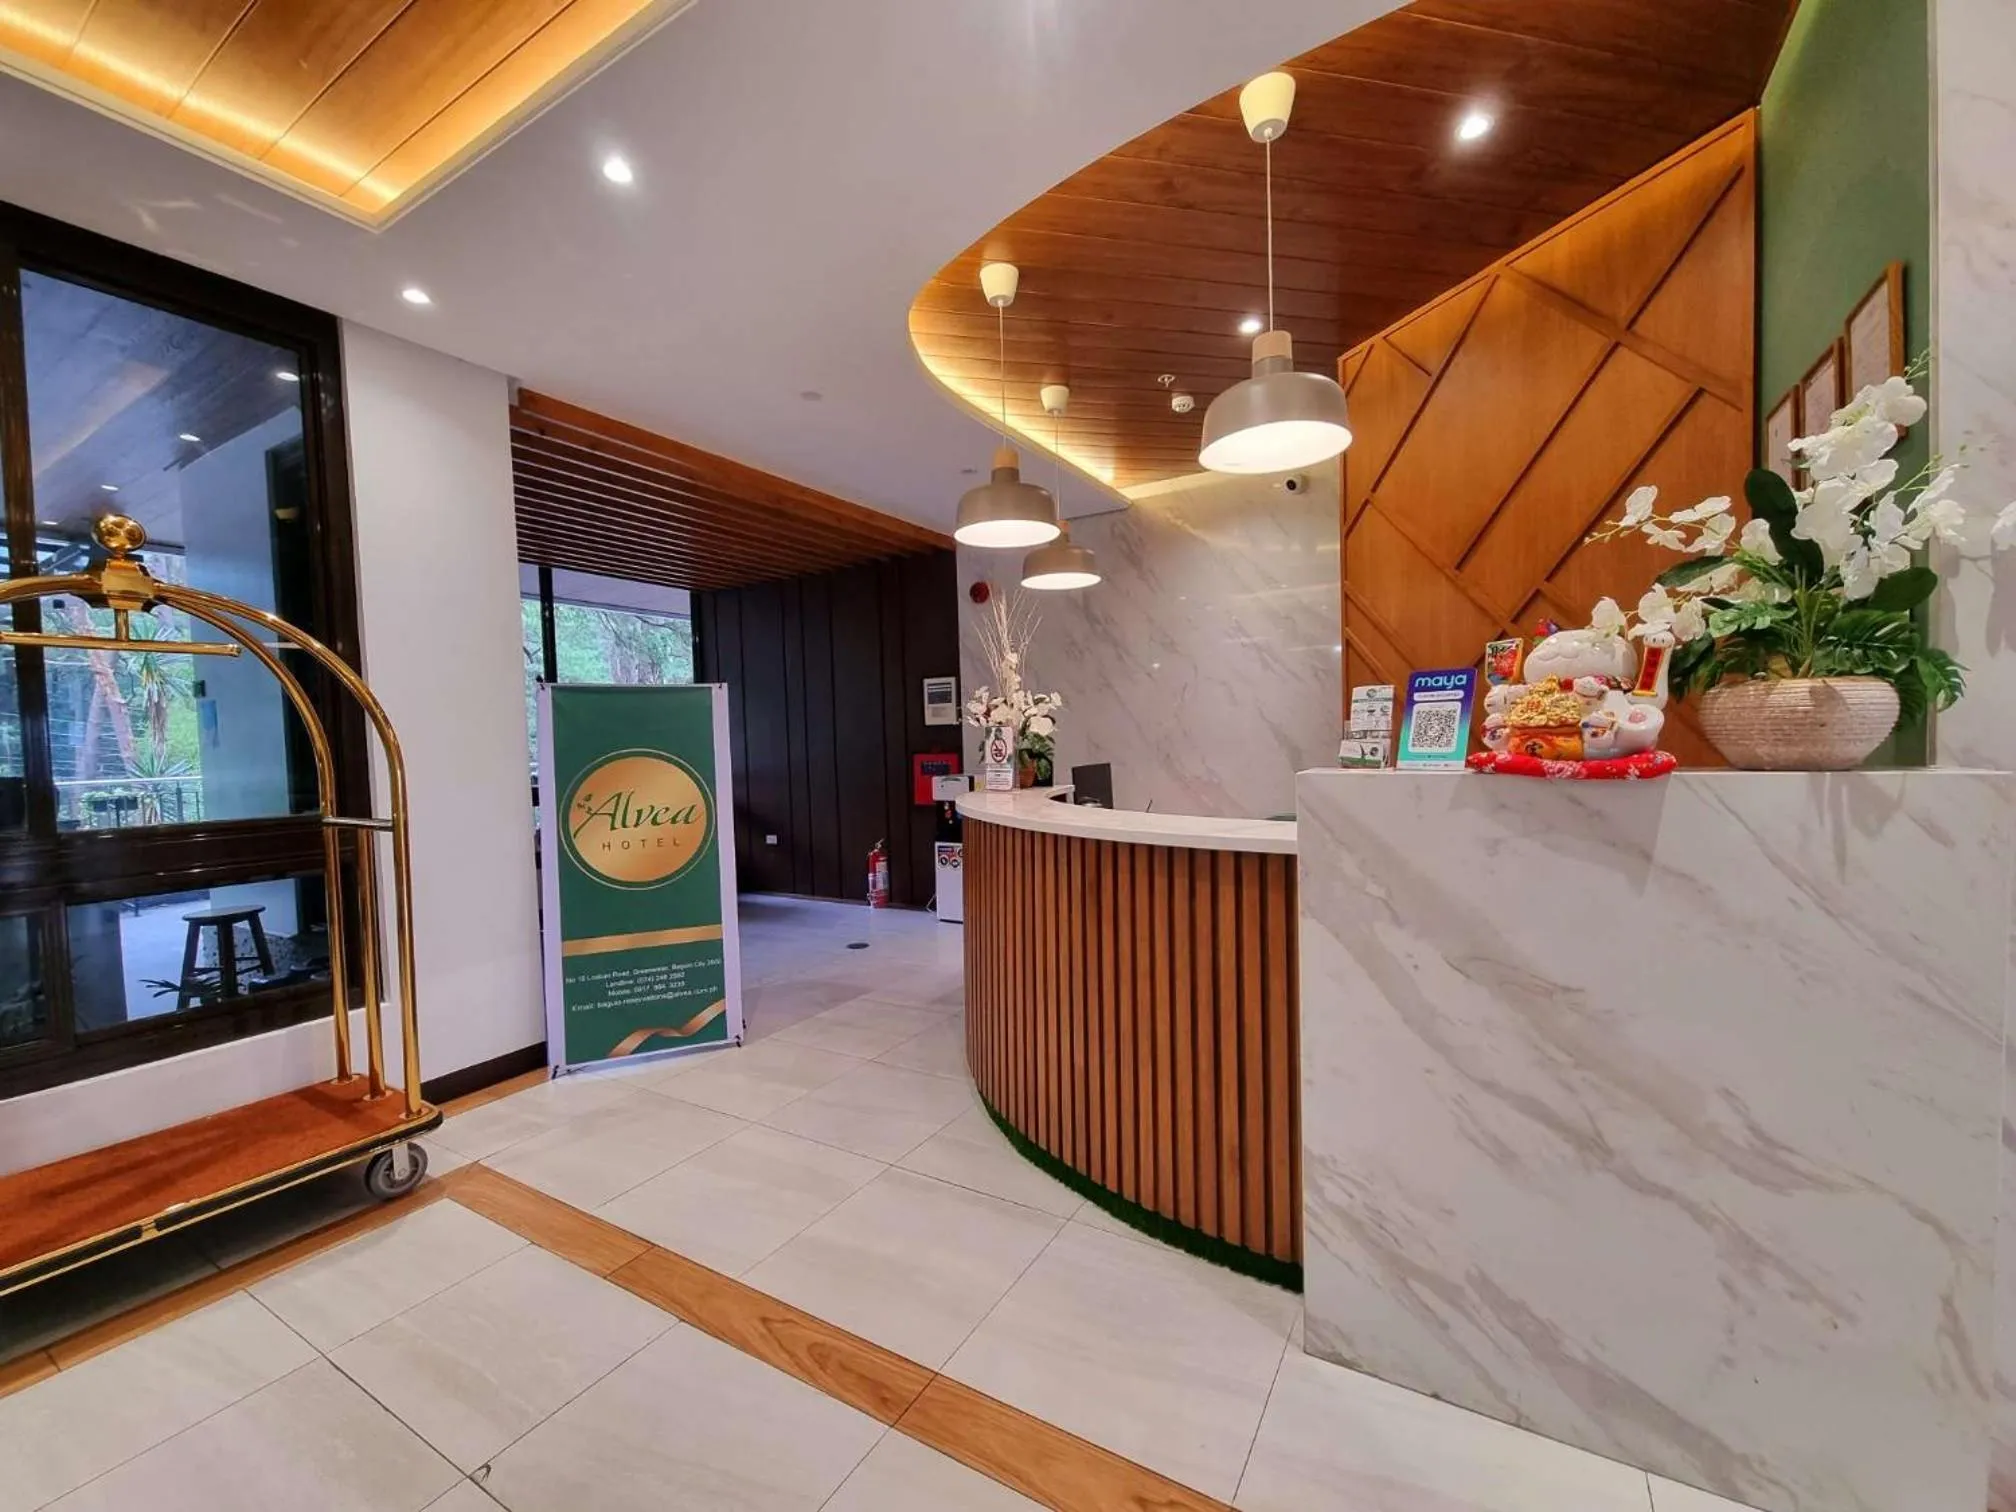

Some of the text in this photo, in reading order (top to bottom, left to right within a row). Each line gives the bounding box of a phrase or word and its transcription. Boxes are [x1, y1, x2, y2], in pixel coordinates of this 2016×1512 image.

[1414, 674, 1467, 689] maya
[574, 790, 704, 839] Alvea
[602, 838, 681, 852] HOTEL
